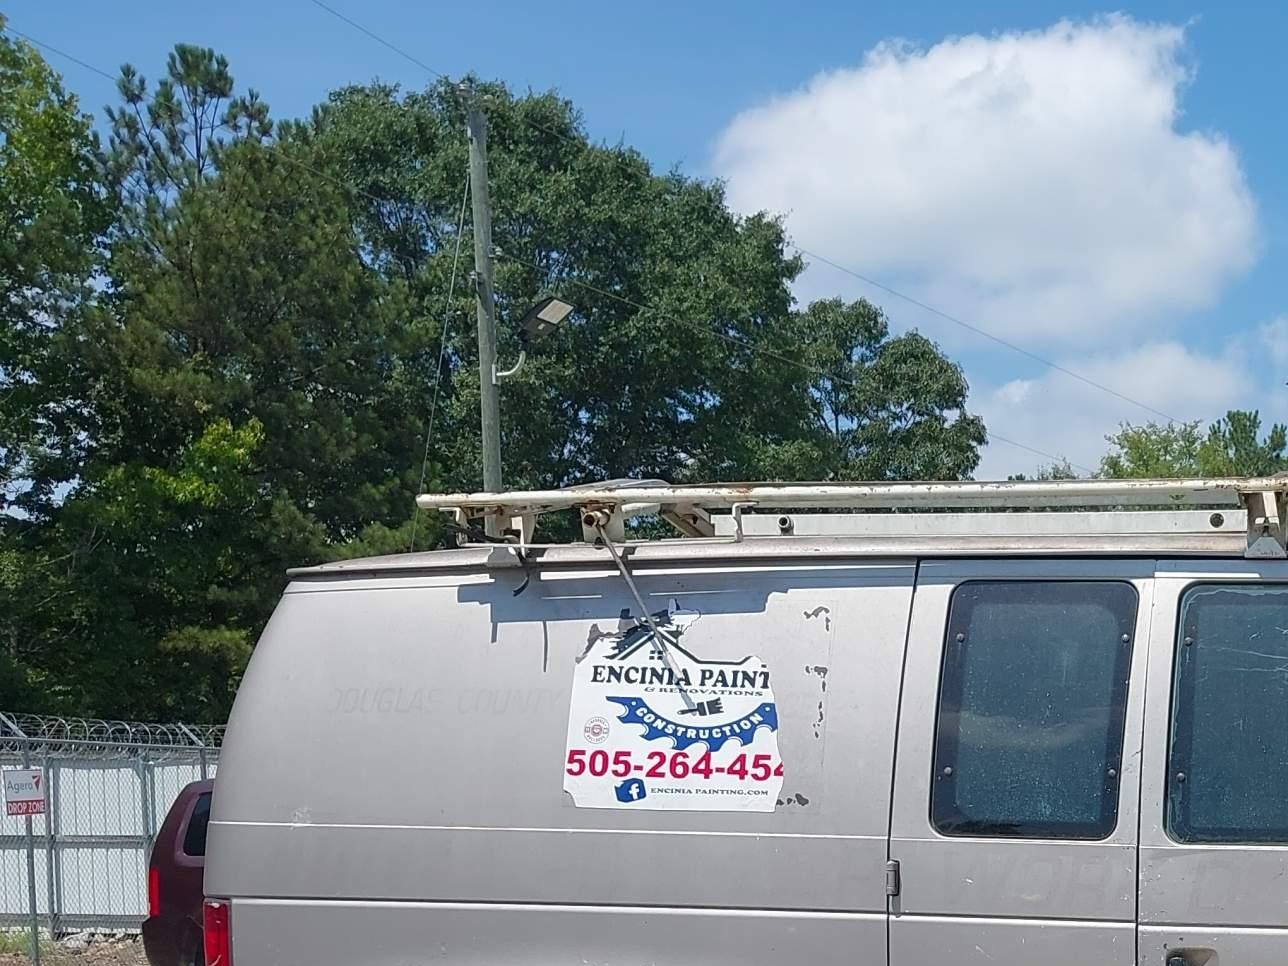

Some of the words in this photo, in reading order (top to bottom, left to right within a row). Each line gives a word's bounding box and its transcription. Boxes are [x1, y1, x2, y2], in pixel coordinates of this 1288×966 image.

[591, 665, 692, 686] ENCINIA
[658, 687, 764, 697] RENOVATIONS
[636, 706, 764, 739] CONSTRUCTION
[7, 780, 33, 794] Agero
[650, 787, 693, 795] ENCINIA
[695, 788, 769, 796] PAINTING.COM
[8, 802, 28, 814] DROP
[28, 801, 46, 813] ZONE
